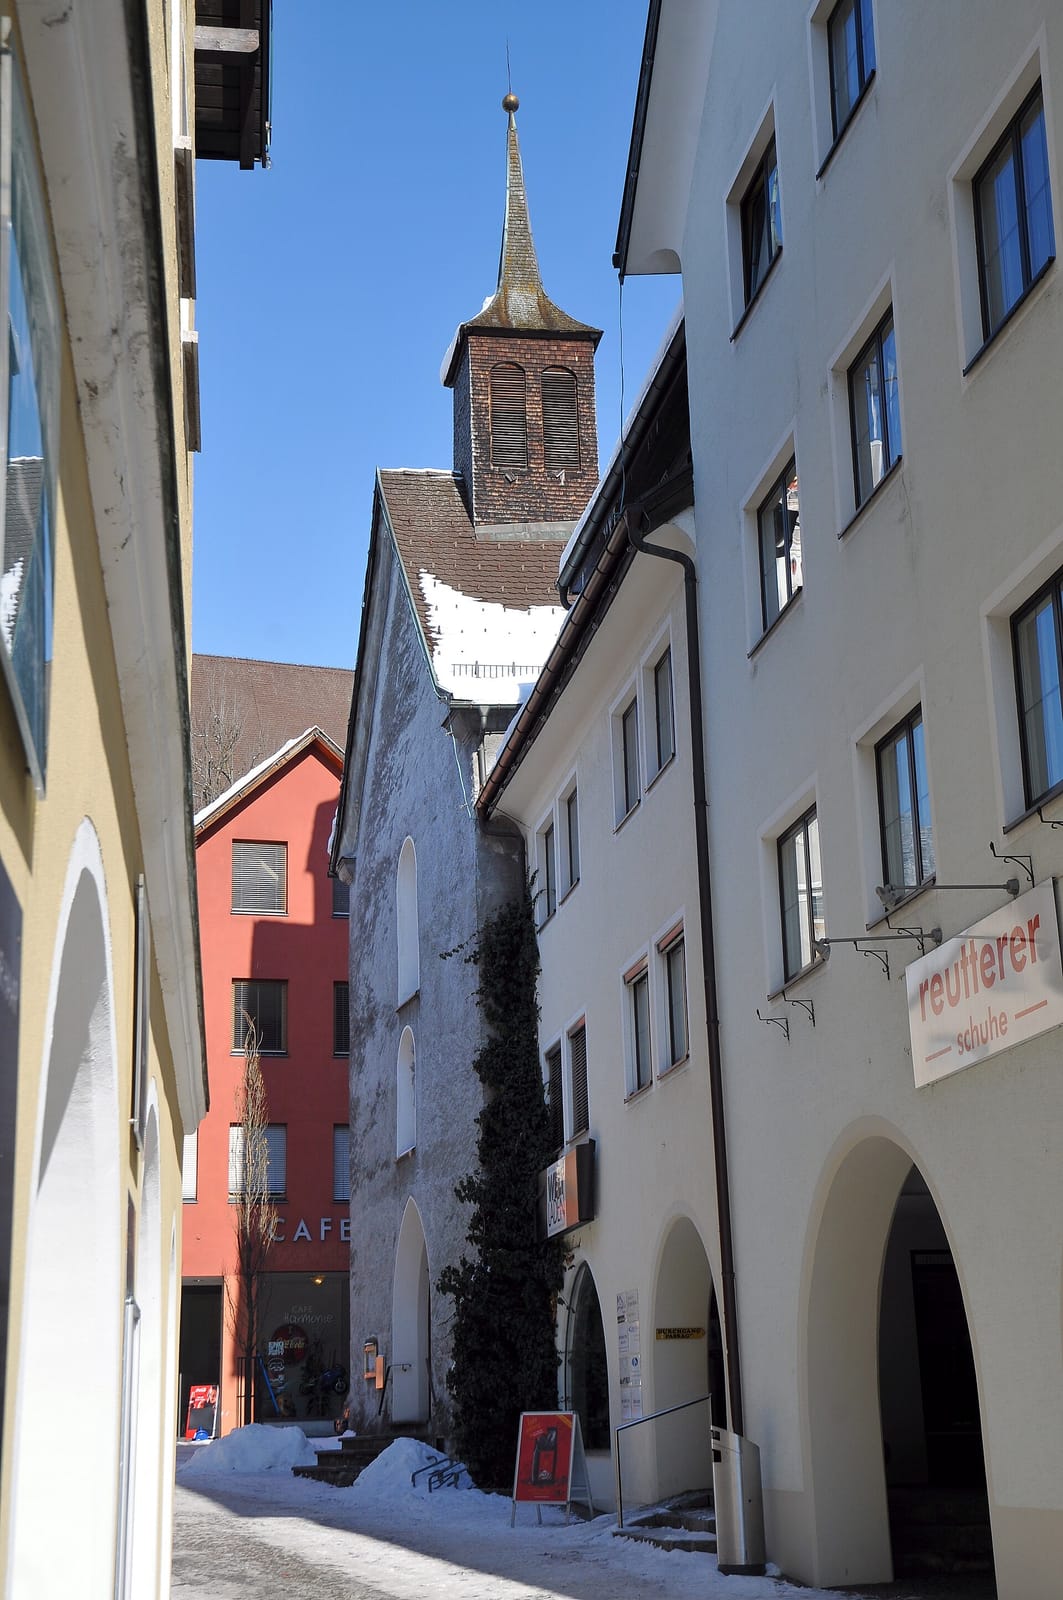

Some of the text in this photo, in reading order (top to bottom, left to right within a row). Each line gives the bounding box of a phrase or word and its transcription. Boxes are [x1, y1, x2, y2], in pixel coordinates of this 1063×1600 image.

[919, 914, 1040, 1022] reutterer
[957, 1006, 1009, 1056] schuhe
[267, 1217, 351, 1241] CAFE
